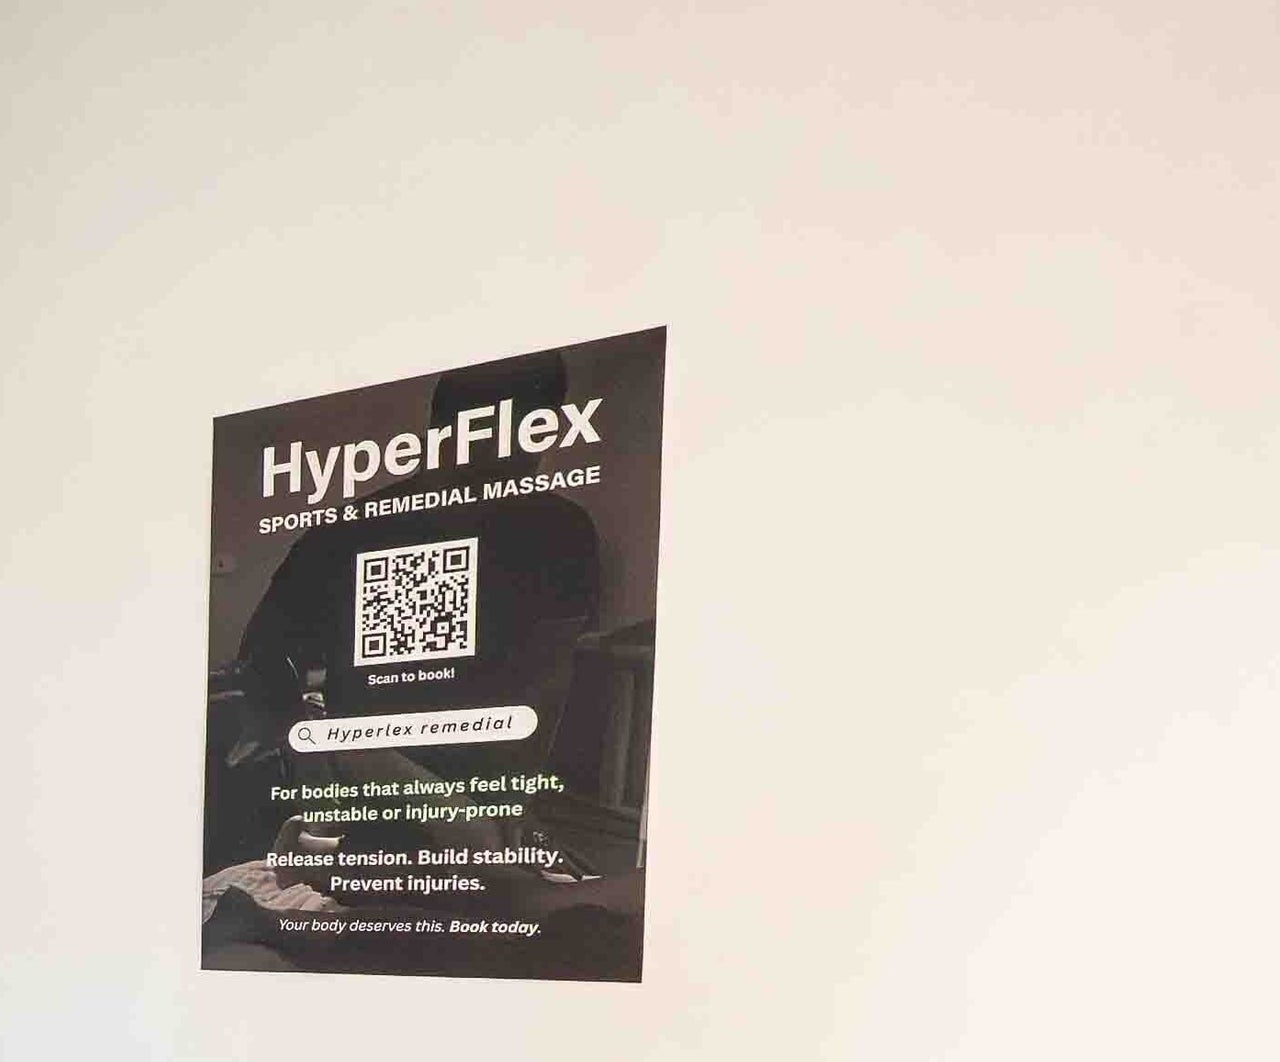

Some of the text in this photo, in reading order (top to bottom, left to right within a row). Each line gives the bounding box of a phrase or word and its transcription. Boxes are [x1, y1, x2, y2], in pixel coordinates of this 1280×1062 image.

[262, 398, 603, 504] HyperFlex
[258, 465, 601, 534] SPORTS & REMEDIAL MASSAGE
[367, 667, 455, 686] Scan to book!
[326, 715, 514, 744] Hyperlex remedial
[271, 774, 565, 801] For bodies that always feel tight,
[302, 803, 523, 823] unstable or injury-prone
[266, 847, 564, 868] Release tension. Build stability.
[330, 874, 486, 894] Prevent injuries.
[279, 918, 542, 936] Your body deserves this. Book today.
